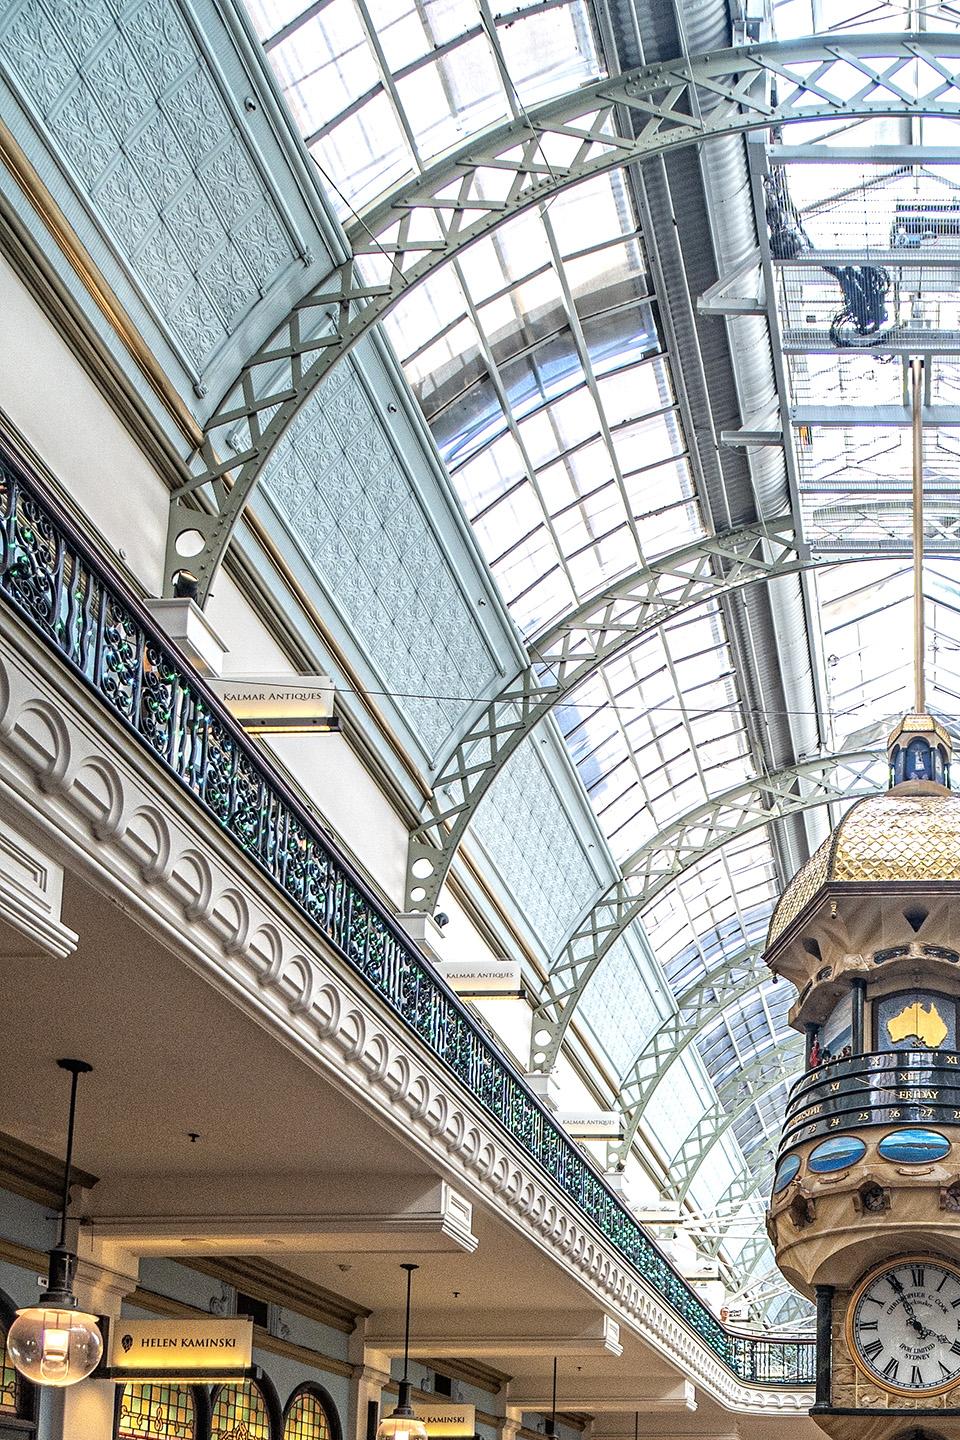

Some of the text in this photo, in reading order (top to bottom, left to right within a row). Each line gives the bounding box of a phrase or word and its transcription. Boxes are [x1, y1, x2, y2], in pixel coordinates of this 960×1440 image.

[223, 692, 322, 702] KALMAR ANTIQUES
[946, 1056, 958, 1064] XI
[899, 1090, 938, 1099] FRIDAY
[858, 1112, 869, 1121] 25
[889, 1108, 901, 1118] 26
[830, 1117, 840, 1127] 24
[886, 1292, 926, 1316] CHRIOPHER
[935, 1298, 949, 1315] COOK
[141, 1338, 236, 1348] HELEN KAMINSKI
[913, 1343, 936, 1354] LIMITED
